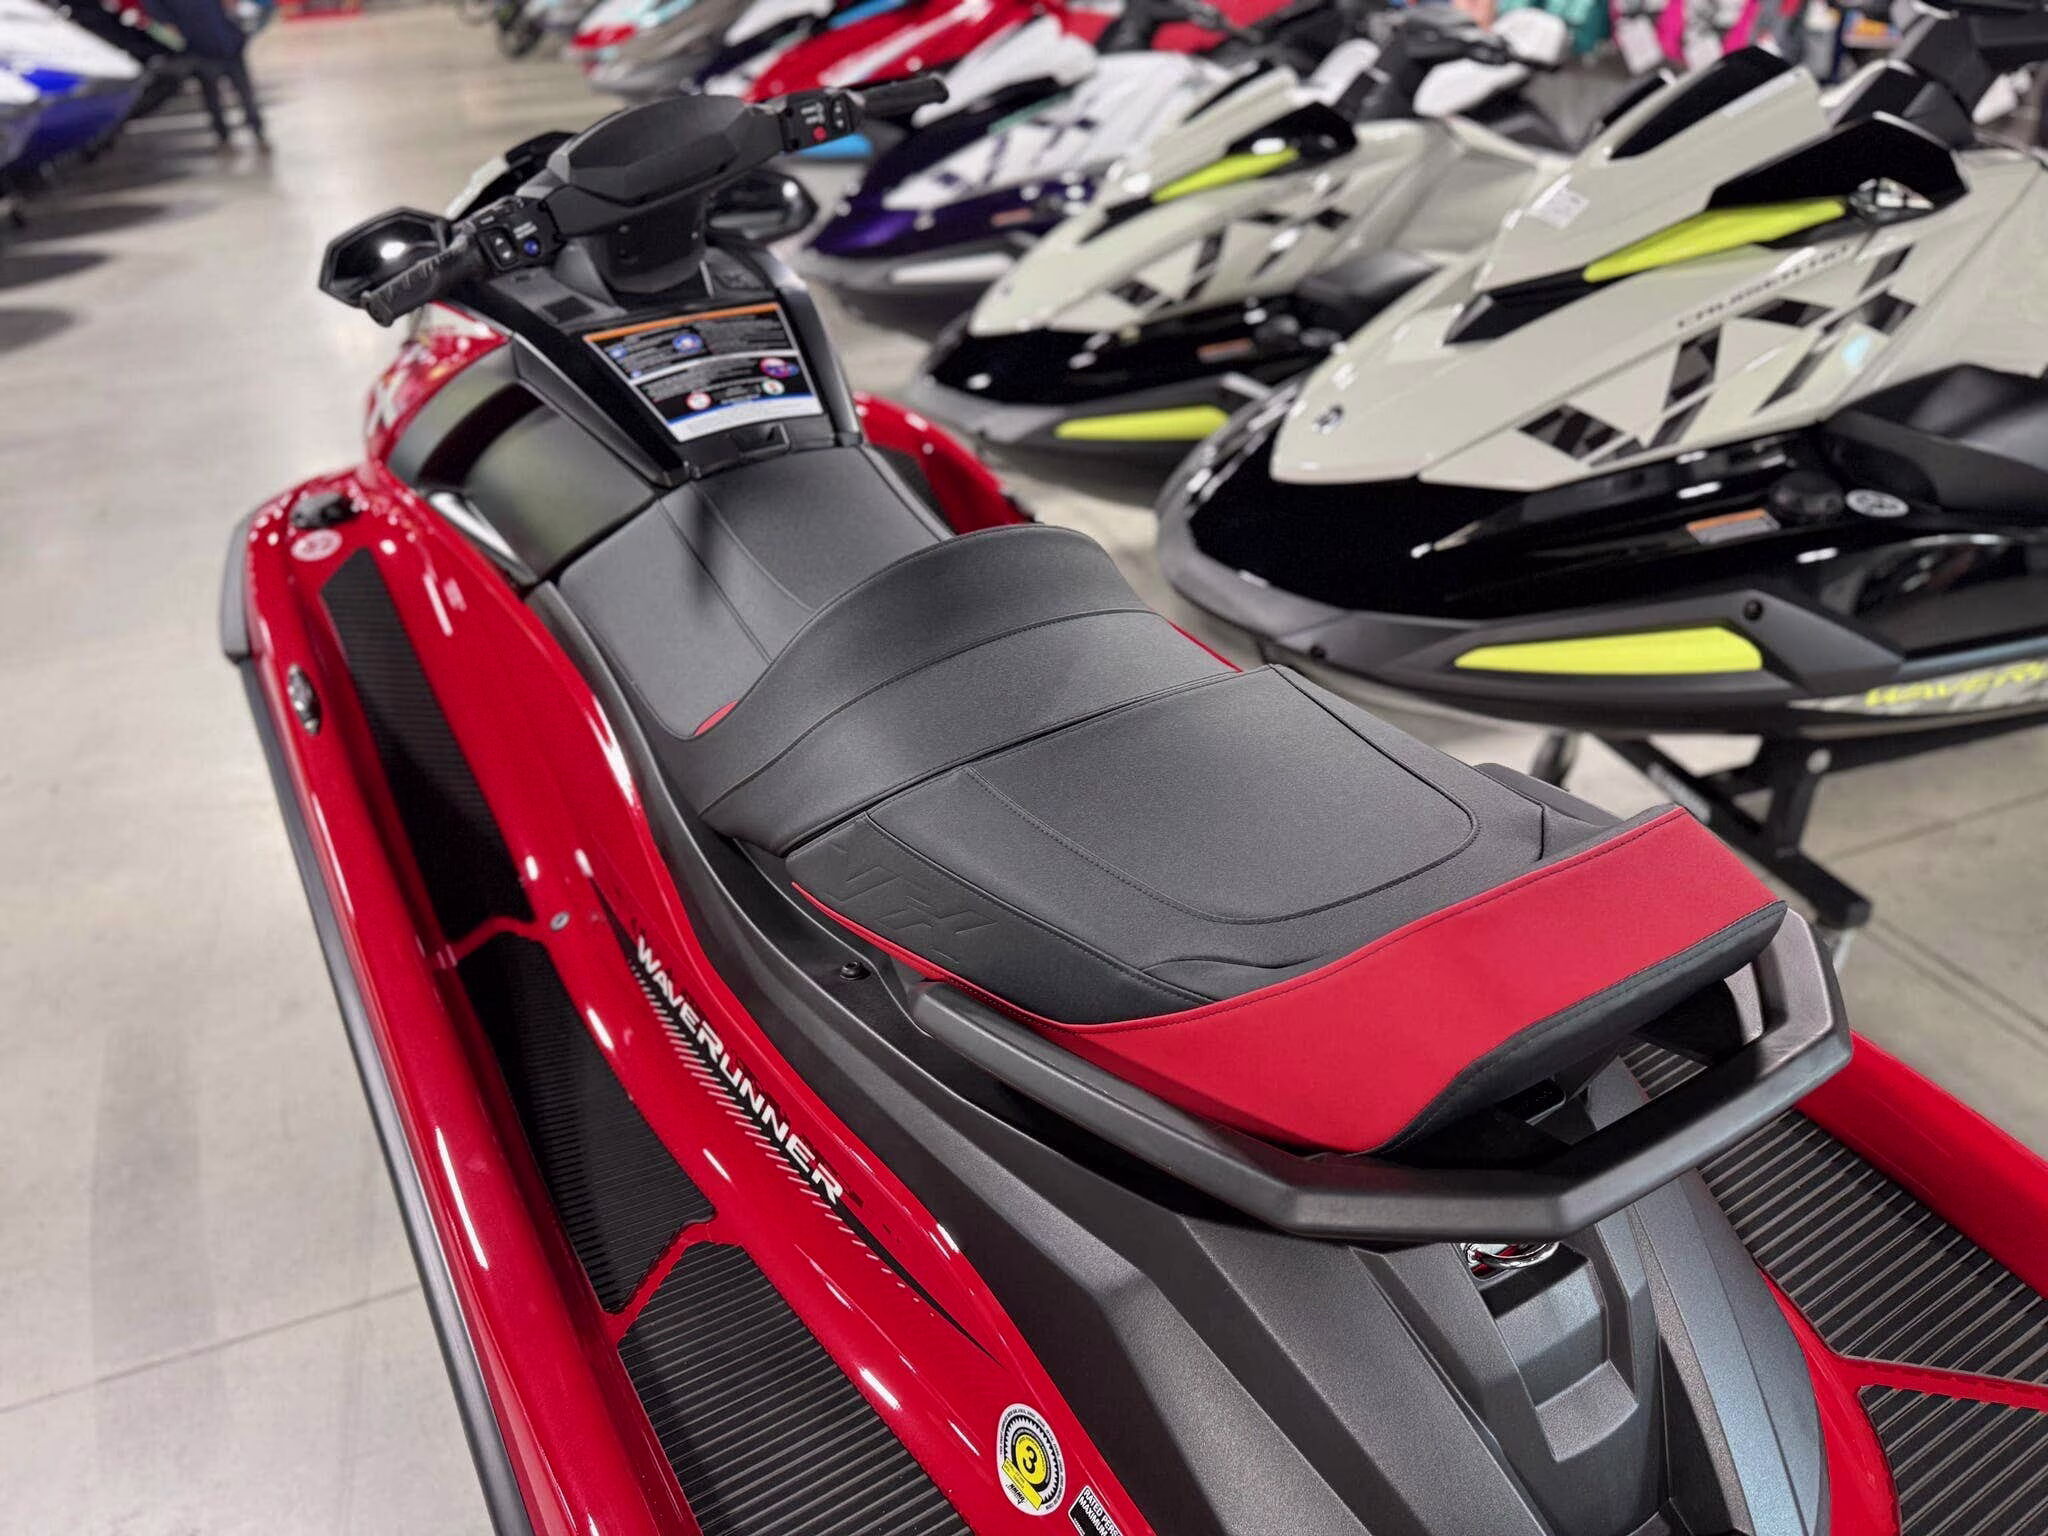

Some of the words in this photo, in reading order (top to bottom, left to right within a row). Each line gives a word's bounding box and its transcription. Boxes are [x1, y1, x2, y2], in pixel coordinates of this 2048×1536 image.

[637, 935, 844, 1206] WAVERUNNER
[1022, 1445, 1038, 1475] 3
[1078, 1496, 1109, 1536] MAXIMUM
[1083, 1489, 1104, 1517] RATED
